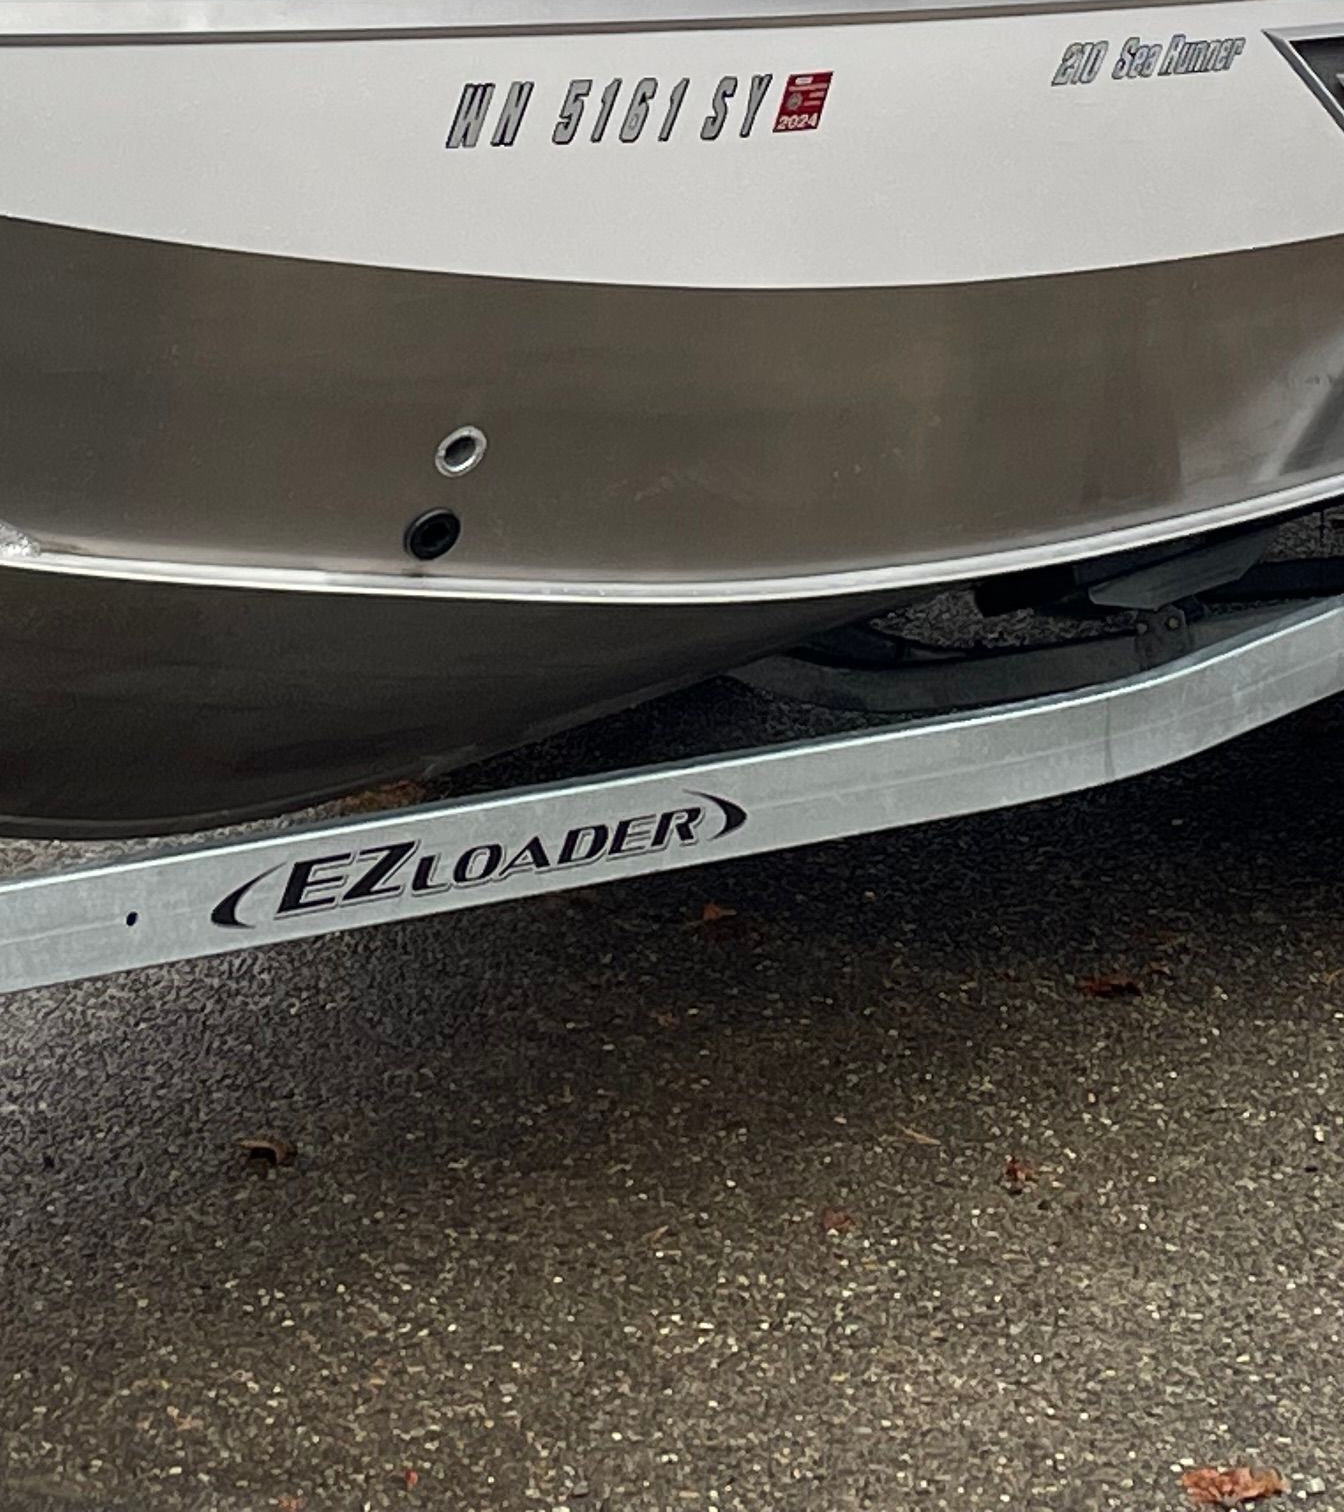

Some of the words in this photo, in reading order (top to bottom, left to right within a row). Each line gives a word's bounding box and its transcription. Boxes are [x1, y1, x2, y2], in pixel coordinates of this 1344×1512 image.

[1051, 40, 1108, 86] 210
[1112, 37, 1163, 79] Sea
[1158, 34, 1246, 76] Runner
[446, 81, 534, 148] WN
[552, 77, 689, 144] 5161
[701, 74, 772, 139] SY
[776, 112, 819, 130] 2024
